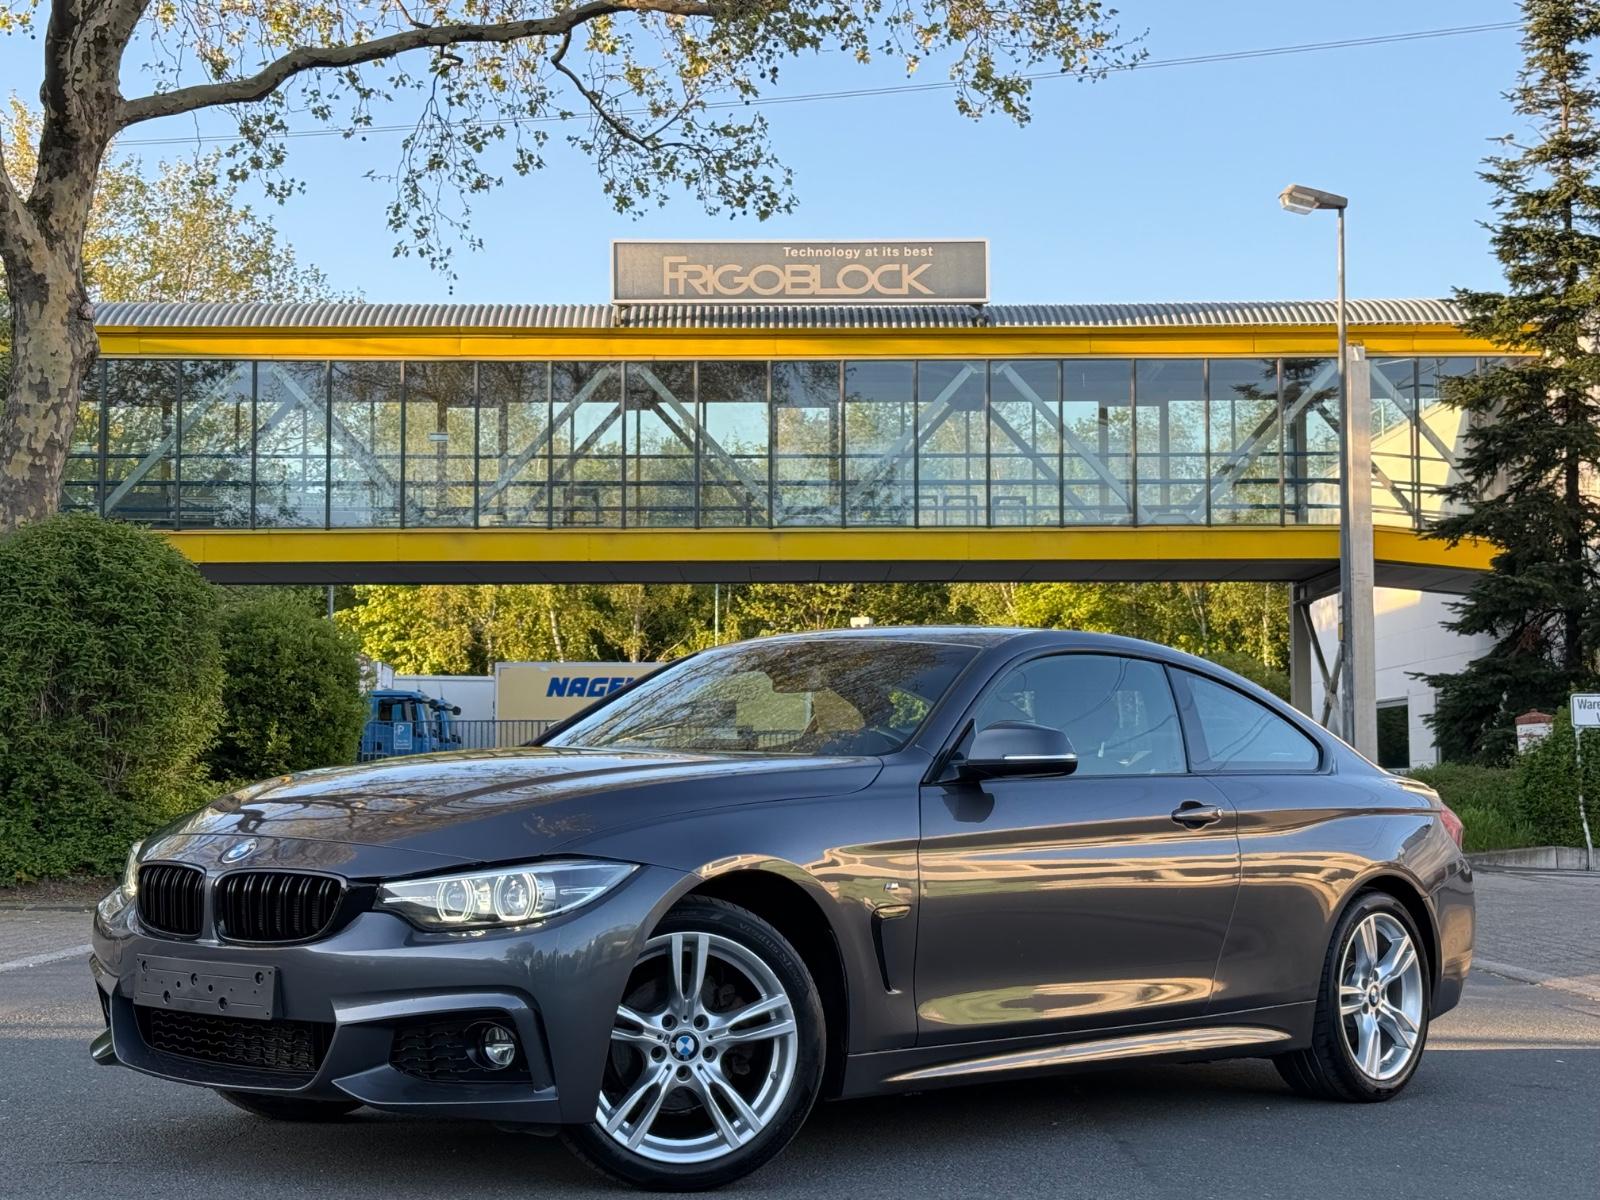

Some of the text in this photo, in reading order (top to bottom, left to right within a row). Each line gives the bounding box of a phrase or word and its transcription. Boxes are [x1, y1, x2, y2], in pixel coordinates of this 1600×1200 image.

[783, 246, 934, 259] Technology at its best
[663, 255, 935, 295] FRIGOBLOCK
[546, 677, 634, 697] NAGE
